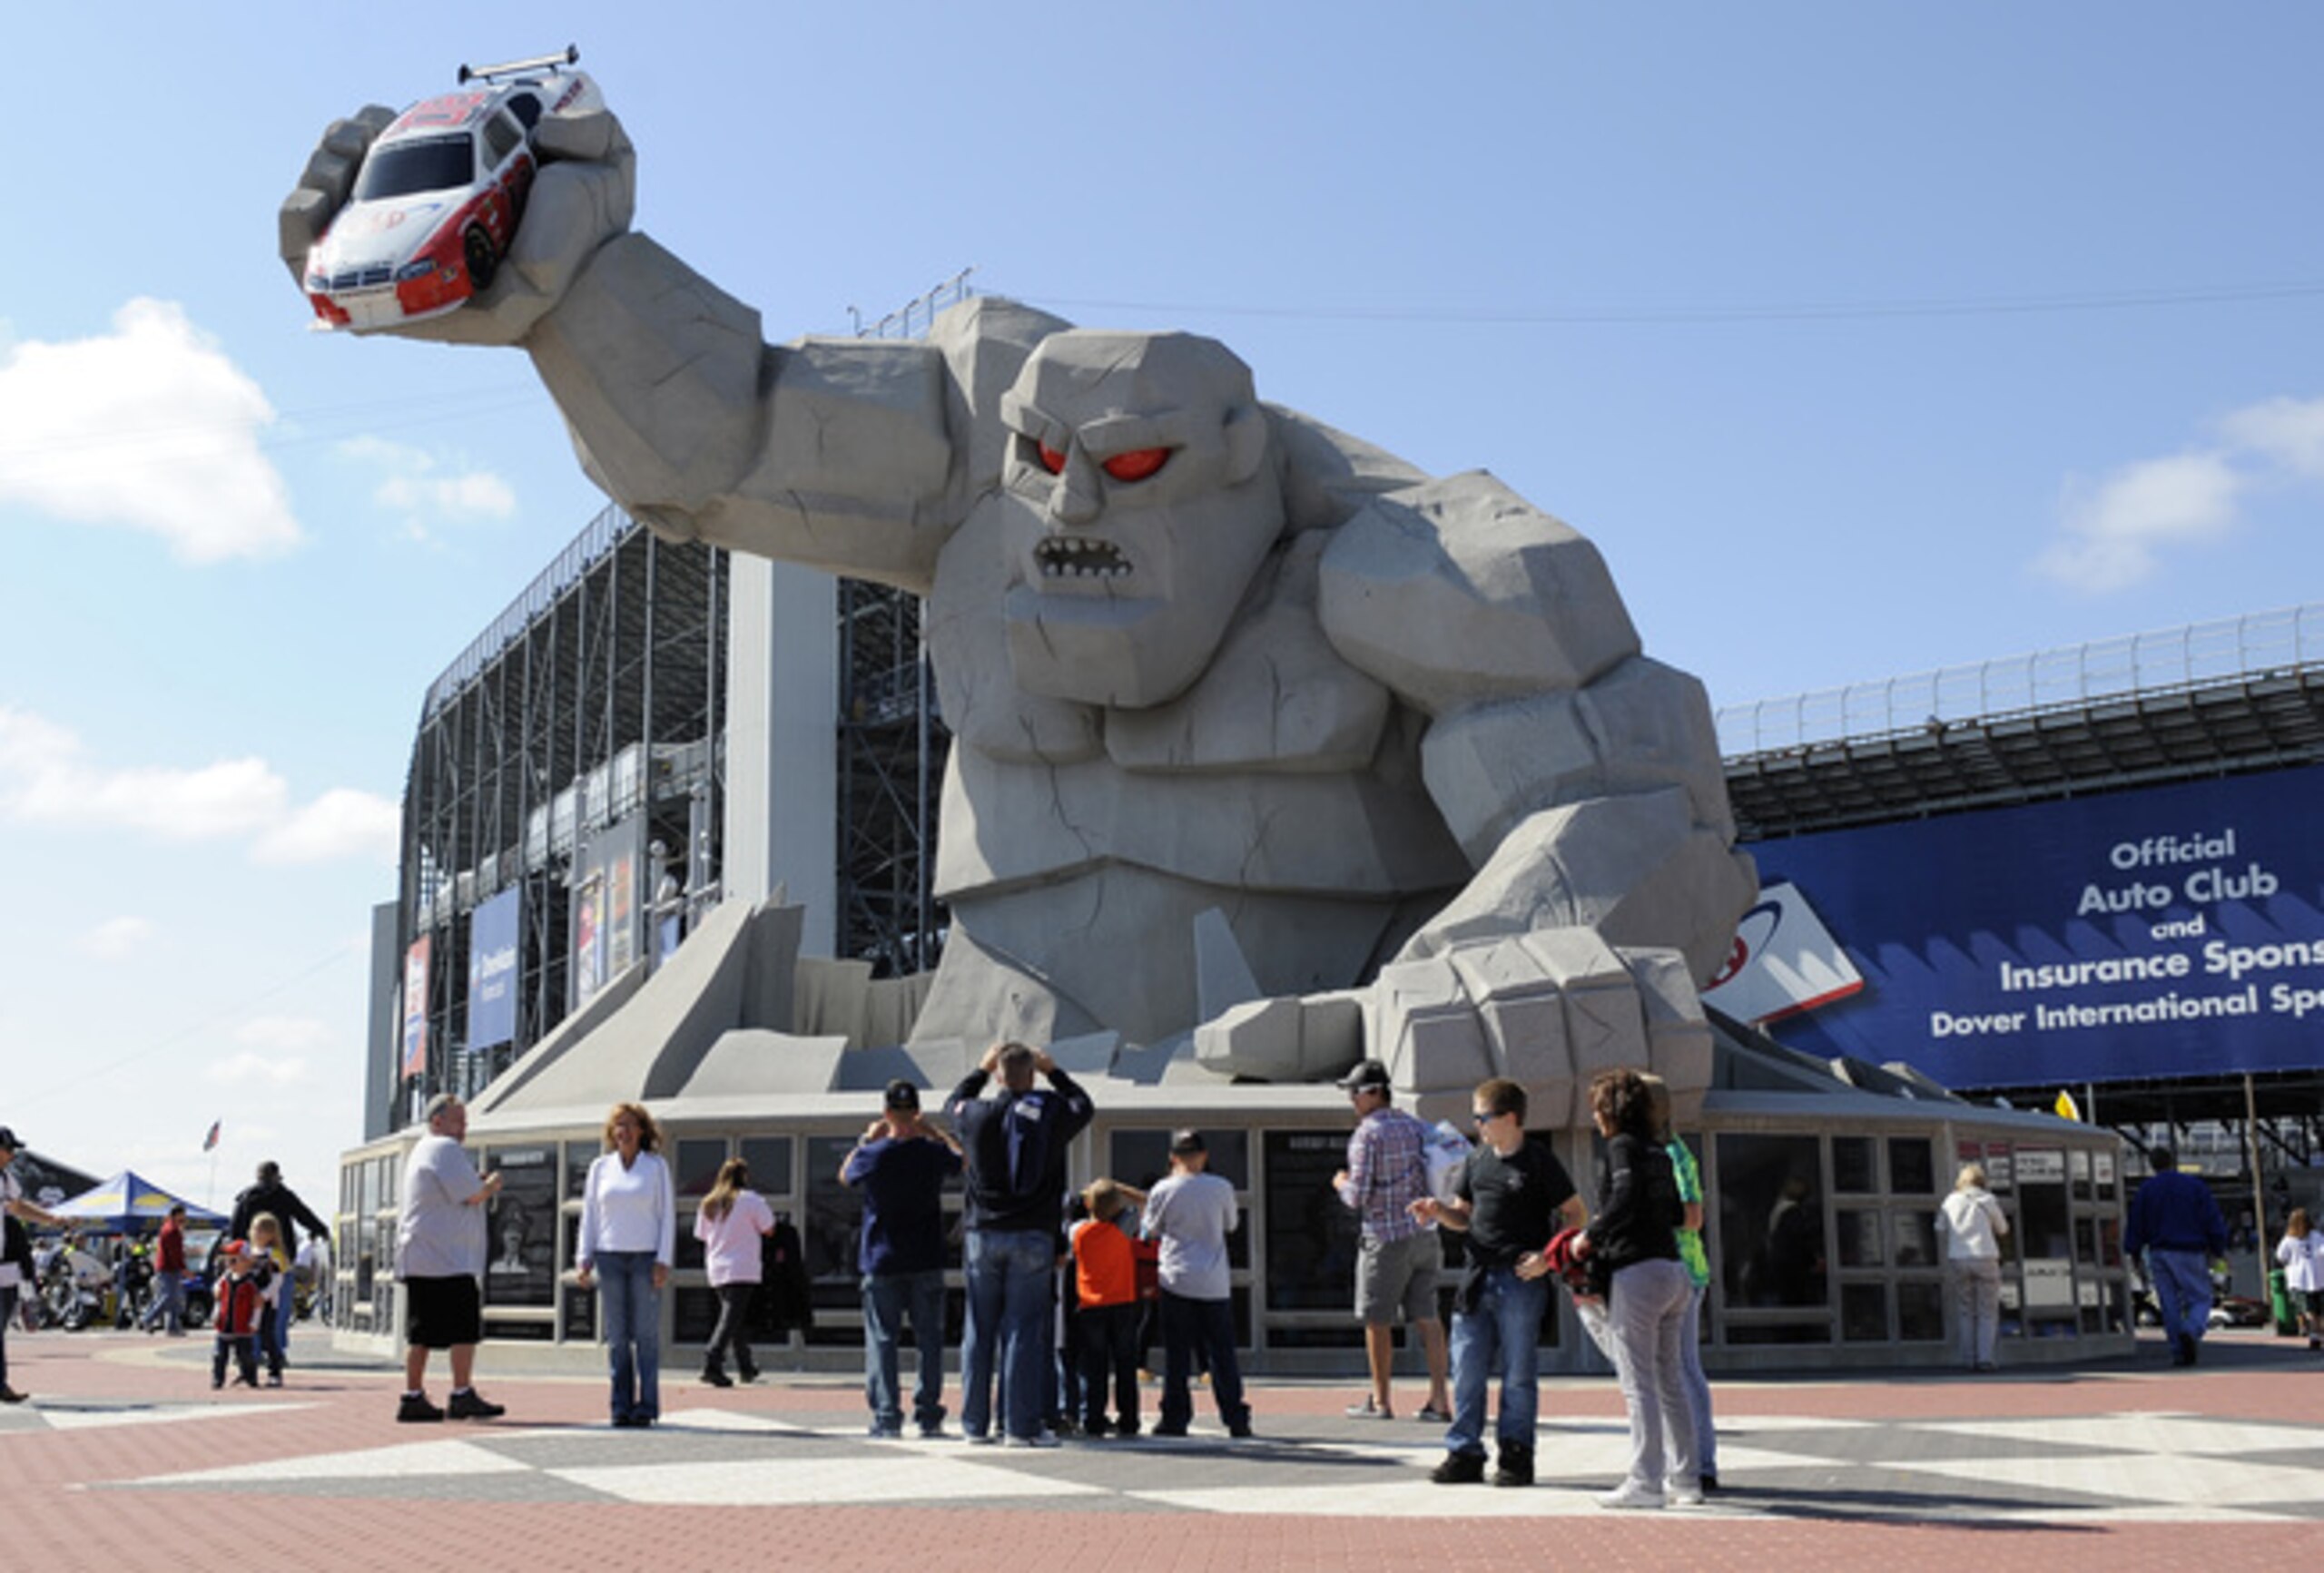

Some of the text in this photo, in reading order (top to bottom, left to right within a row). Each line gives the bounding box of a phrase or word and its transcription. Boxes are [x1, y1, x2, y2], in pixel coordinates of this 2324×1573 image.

[2110, 828, 2236, 870] Official
[2076, 862, 2279, 916] Auto Club
[2150, 912, 2206, 940] and
[2000, 953, 2190, 991] Insurance
[1930, 983, 2324, 1037] Dover International Sp
